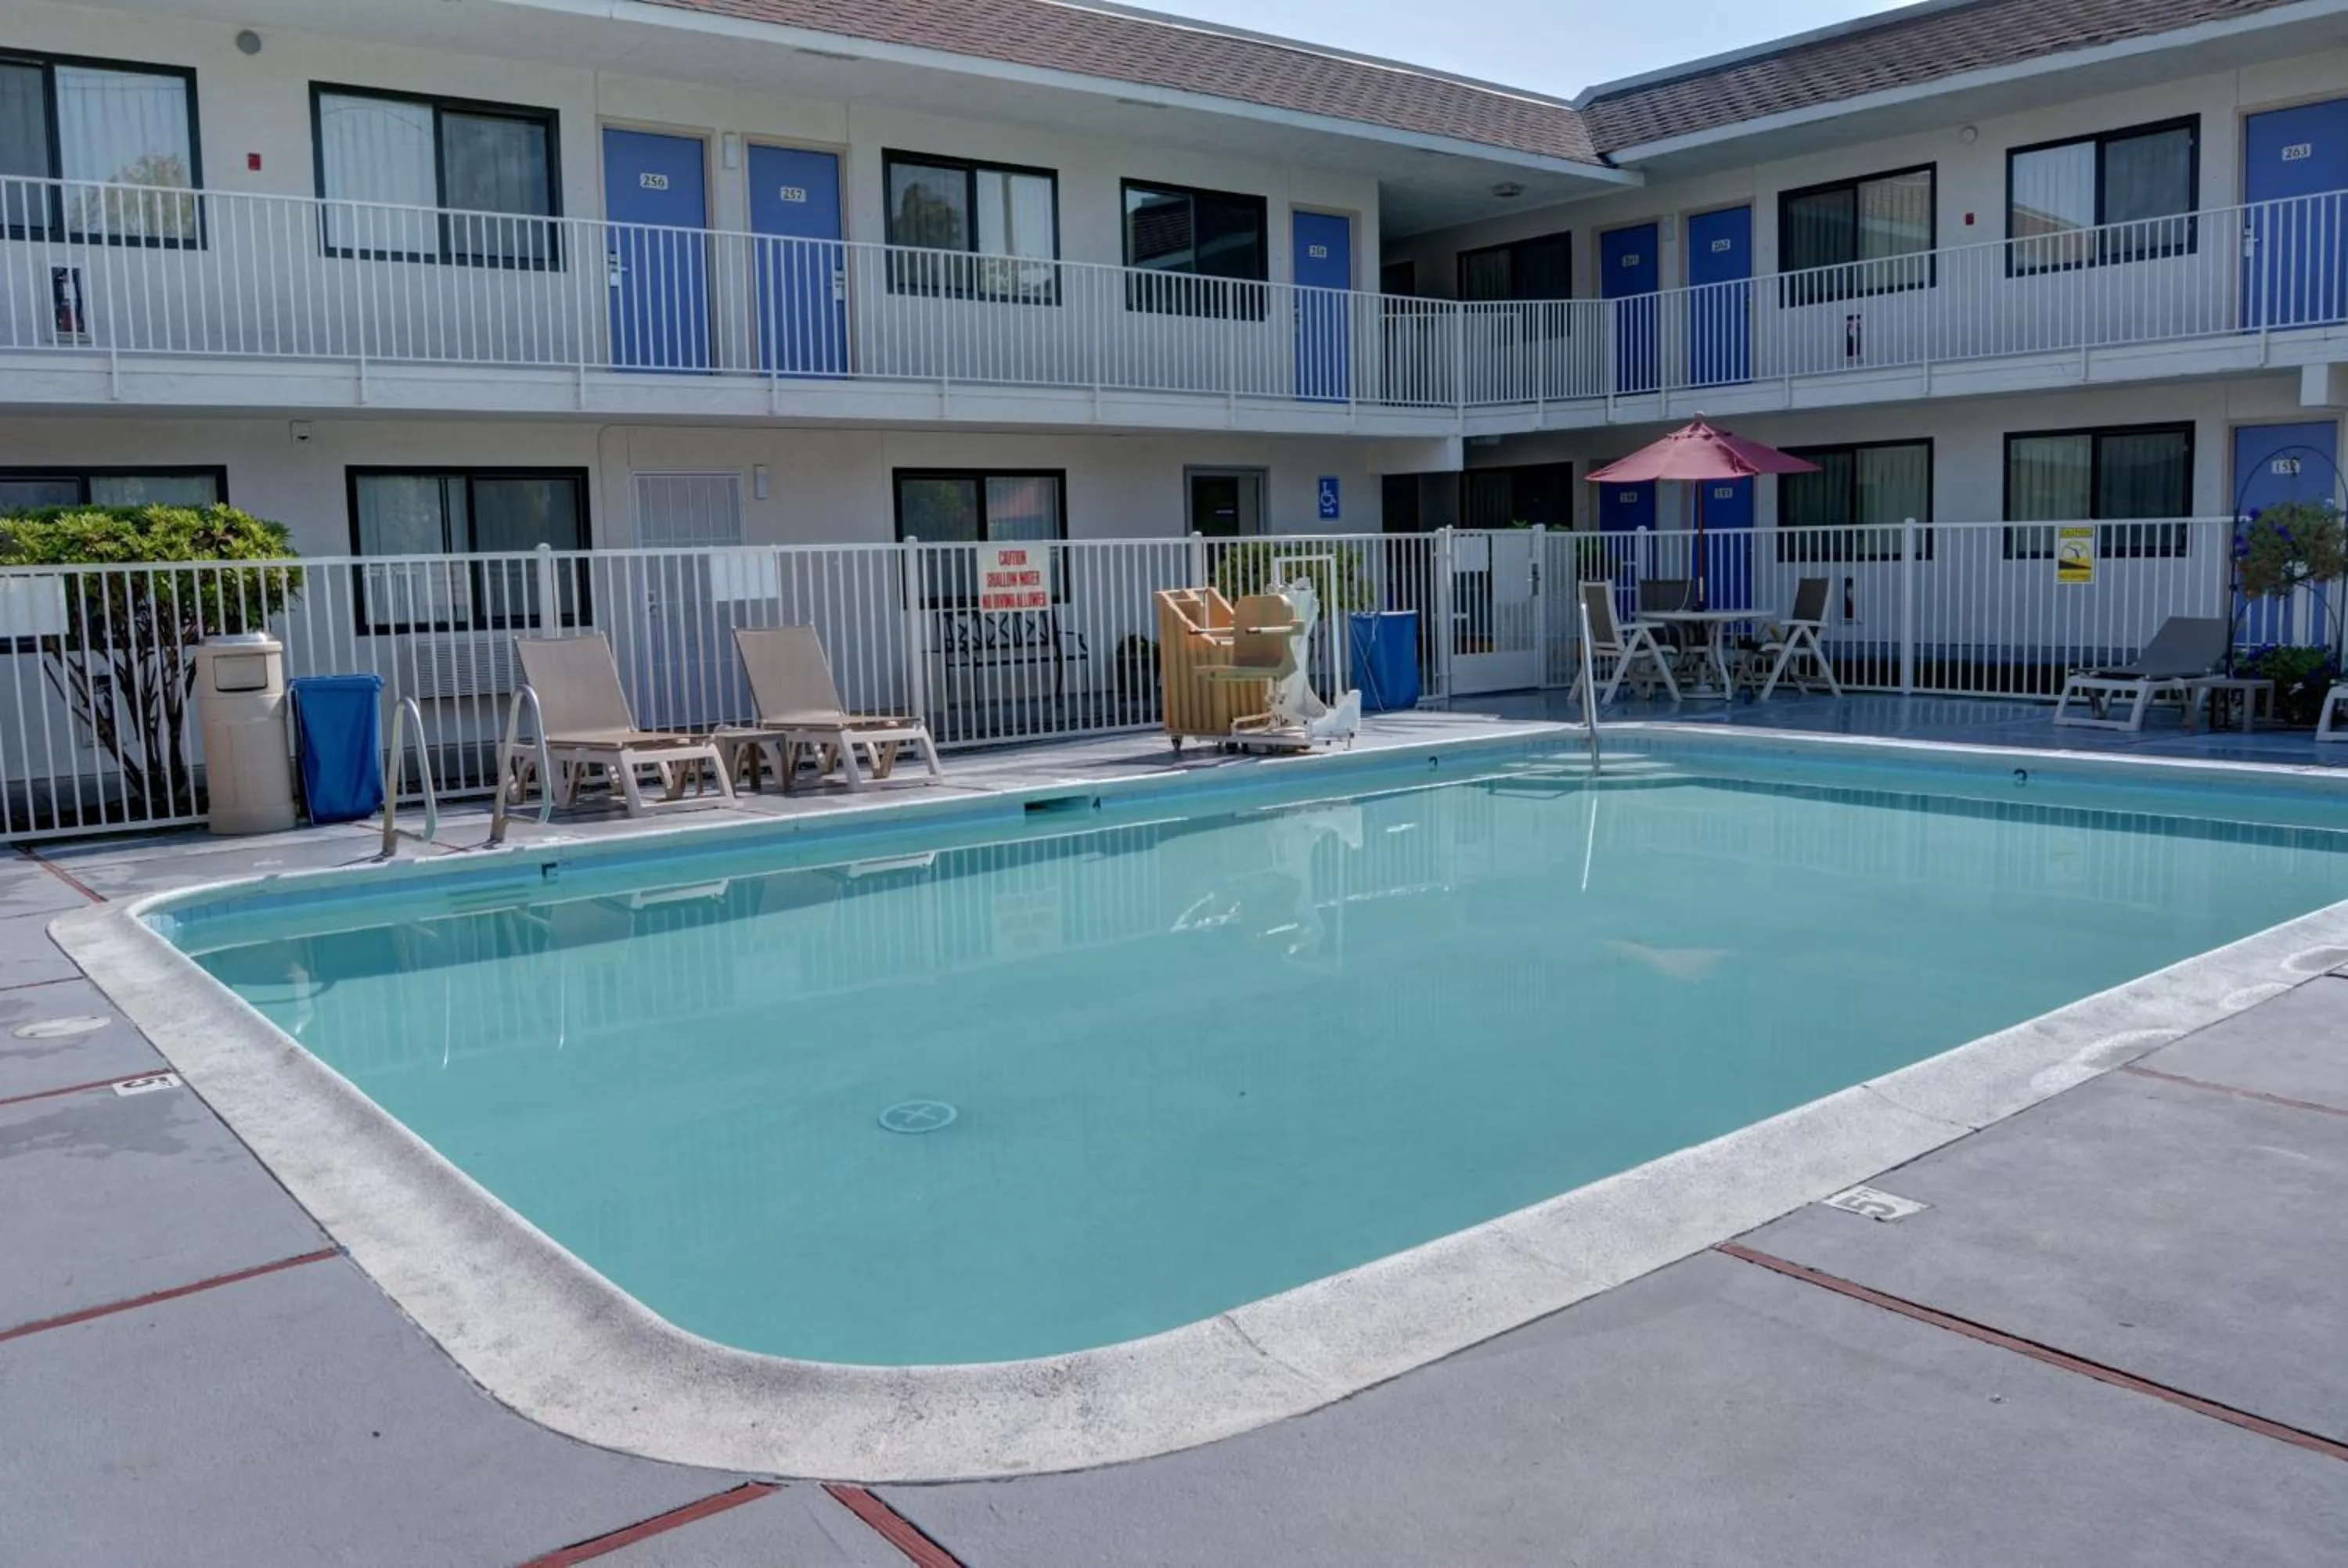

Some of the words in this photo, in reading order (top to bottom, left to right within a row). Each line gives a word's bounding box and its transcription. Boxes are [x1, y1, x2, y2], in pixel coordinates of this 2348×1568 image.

[2284, 145, 2309, 159] 263
[643, 174, 665, 188] 256
[782, 188, 803, 200] 257
[998, 549, 1027, 566] CAUTION
[986, 571, 1018, 588] SHALLOW
[1019, 570, 1040, 587] WATER
[982, 593, 992, 610] NO
[992, 592, 1015, 609] DIVING
[1017, 591, 1047, 608] ALLOWED
[1835, 1195, 1897, 1217] 5
